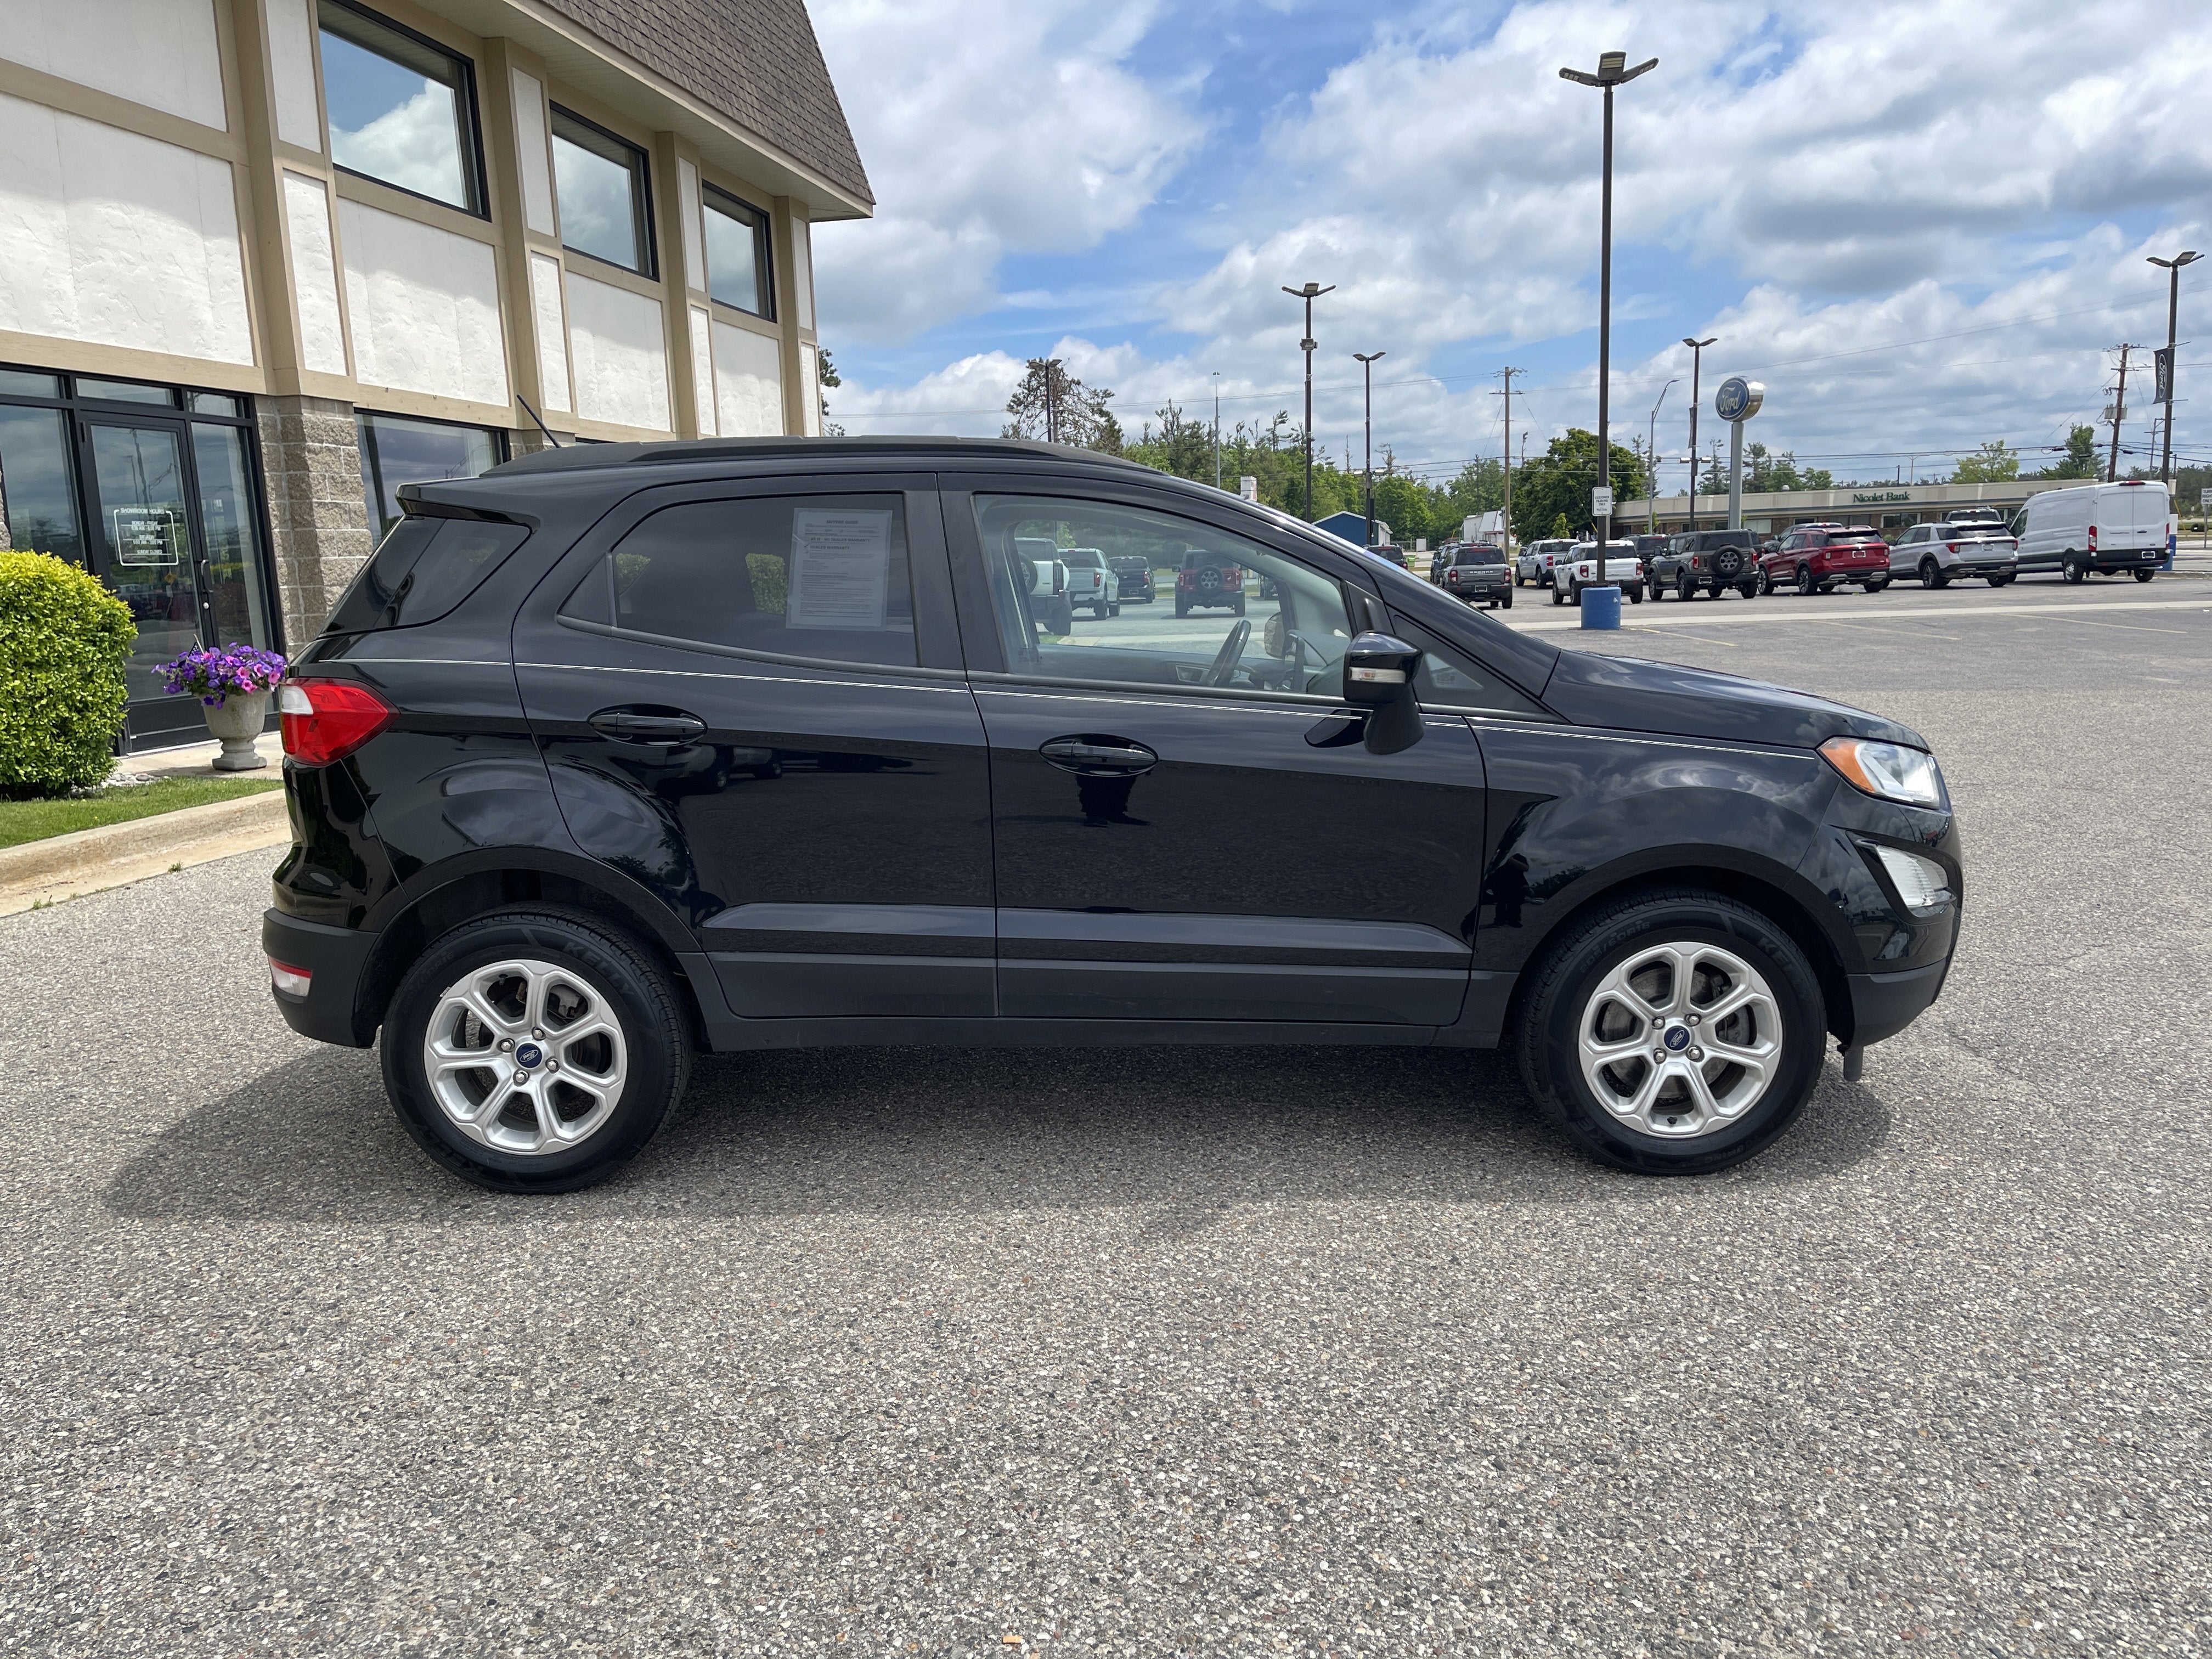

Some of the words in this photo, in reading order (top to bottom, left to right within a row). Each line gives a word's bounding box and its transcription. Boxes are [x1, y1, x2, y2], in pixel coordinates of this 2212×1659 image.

[1720, 386, 1741, 412] Ford
[1853, 493, 1883, 503] Nicolet
[1886, 491, 1911, 501] Bank
[562, 941, 635, 996] KELLY
